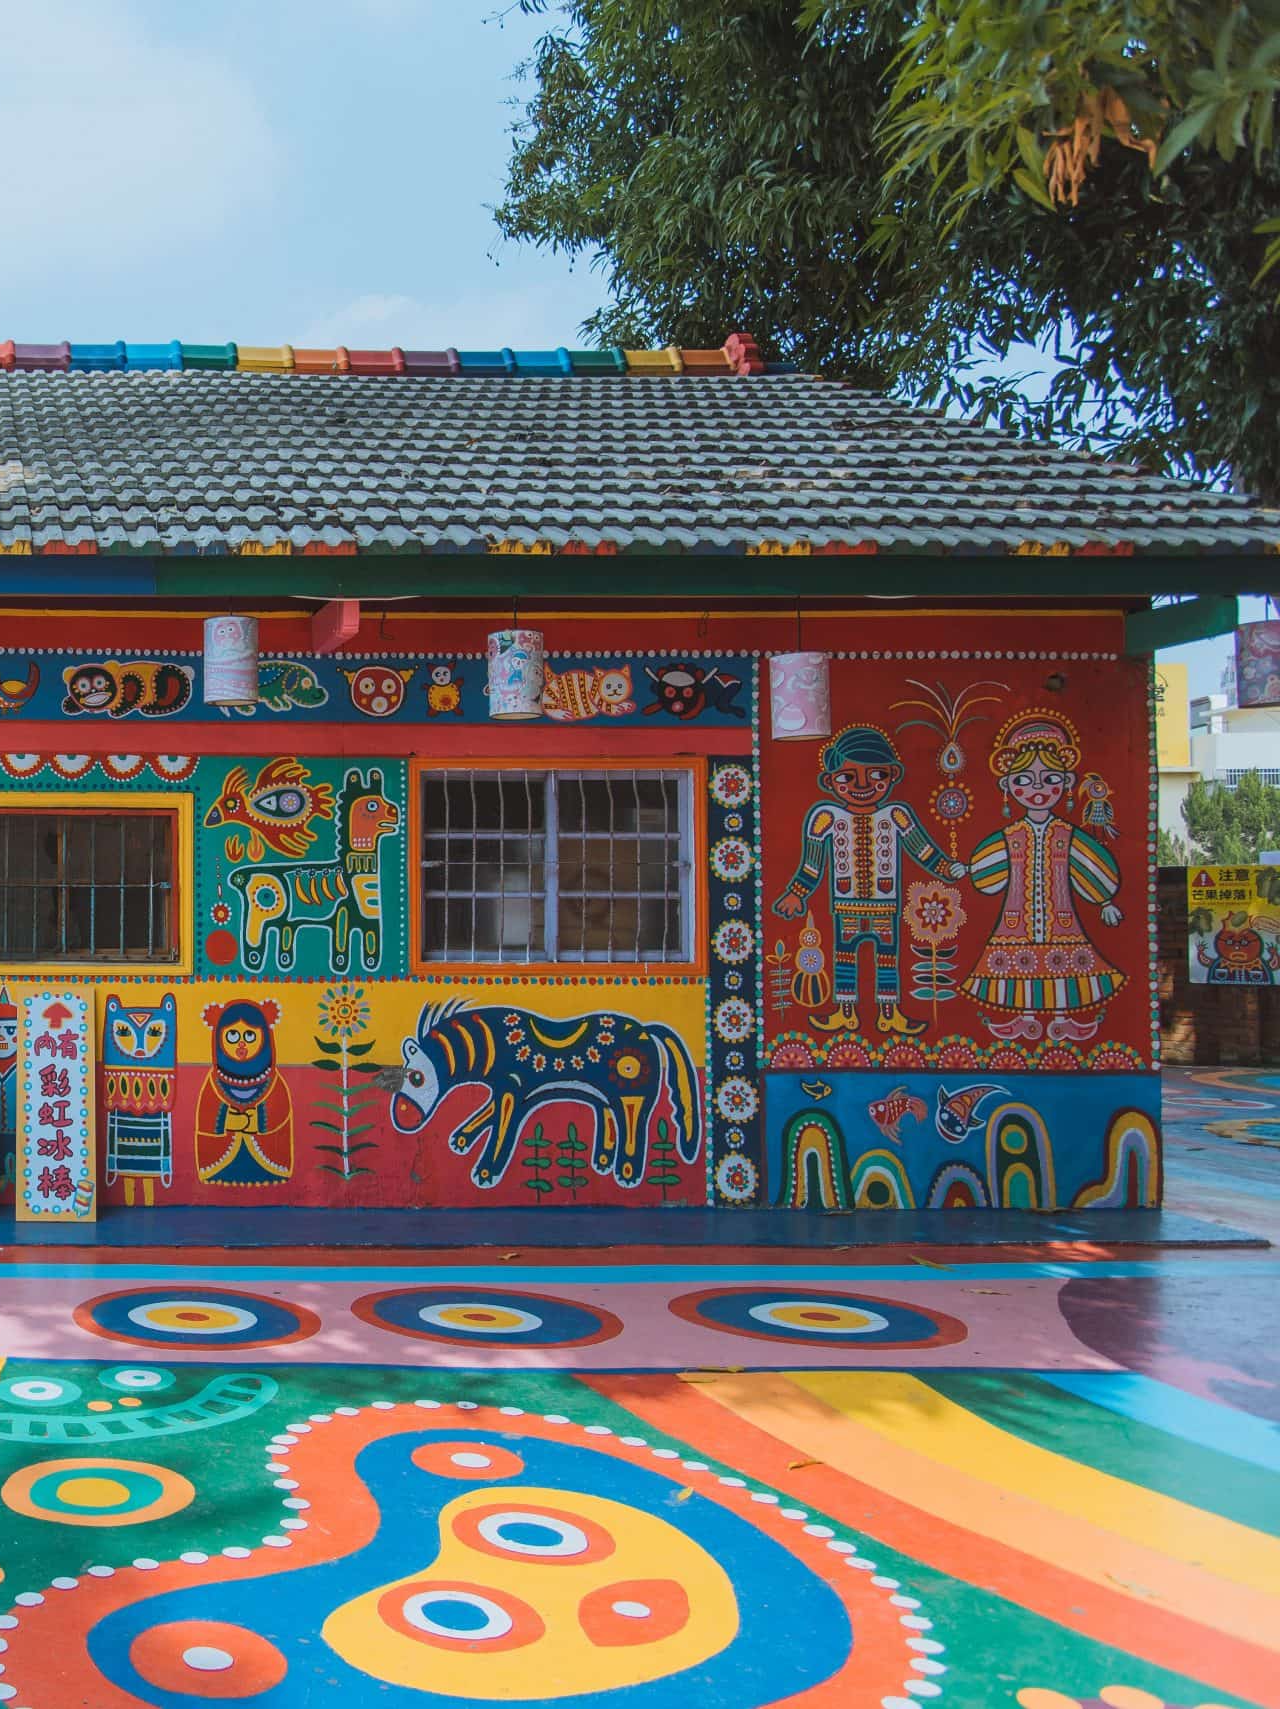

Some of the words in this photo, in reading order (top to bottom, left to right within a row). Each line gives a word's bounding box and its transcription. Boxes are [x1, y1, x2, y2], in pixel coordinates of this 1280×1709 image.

[1219, 869, 1250, 881] 注意
[37, 1063, 77, 1201] 彩虹冰棒
